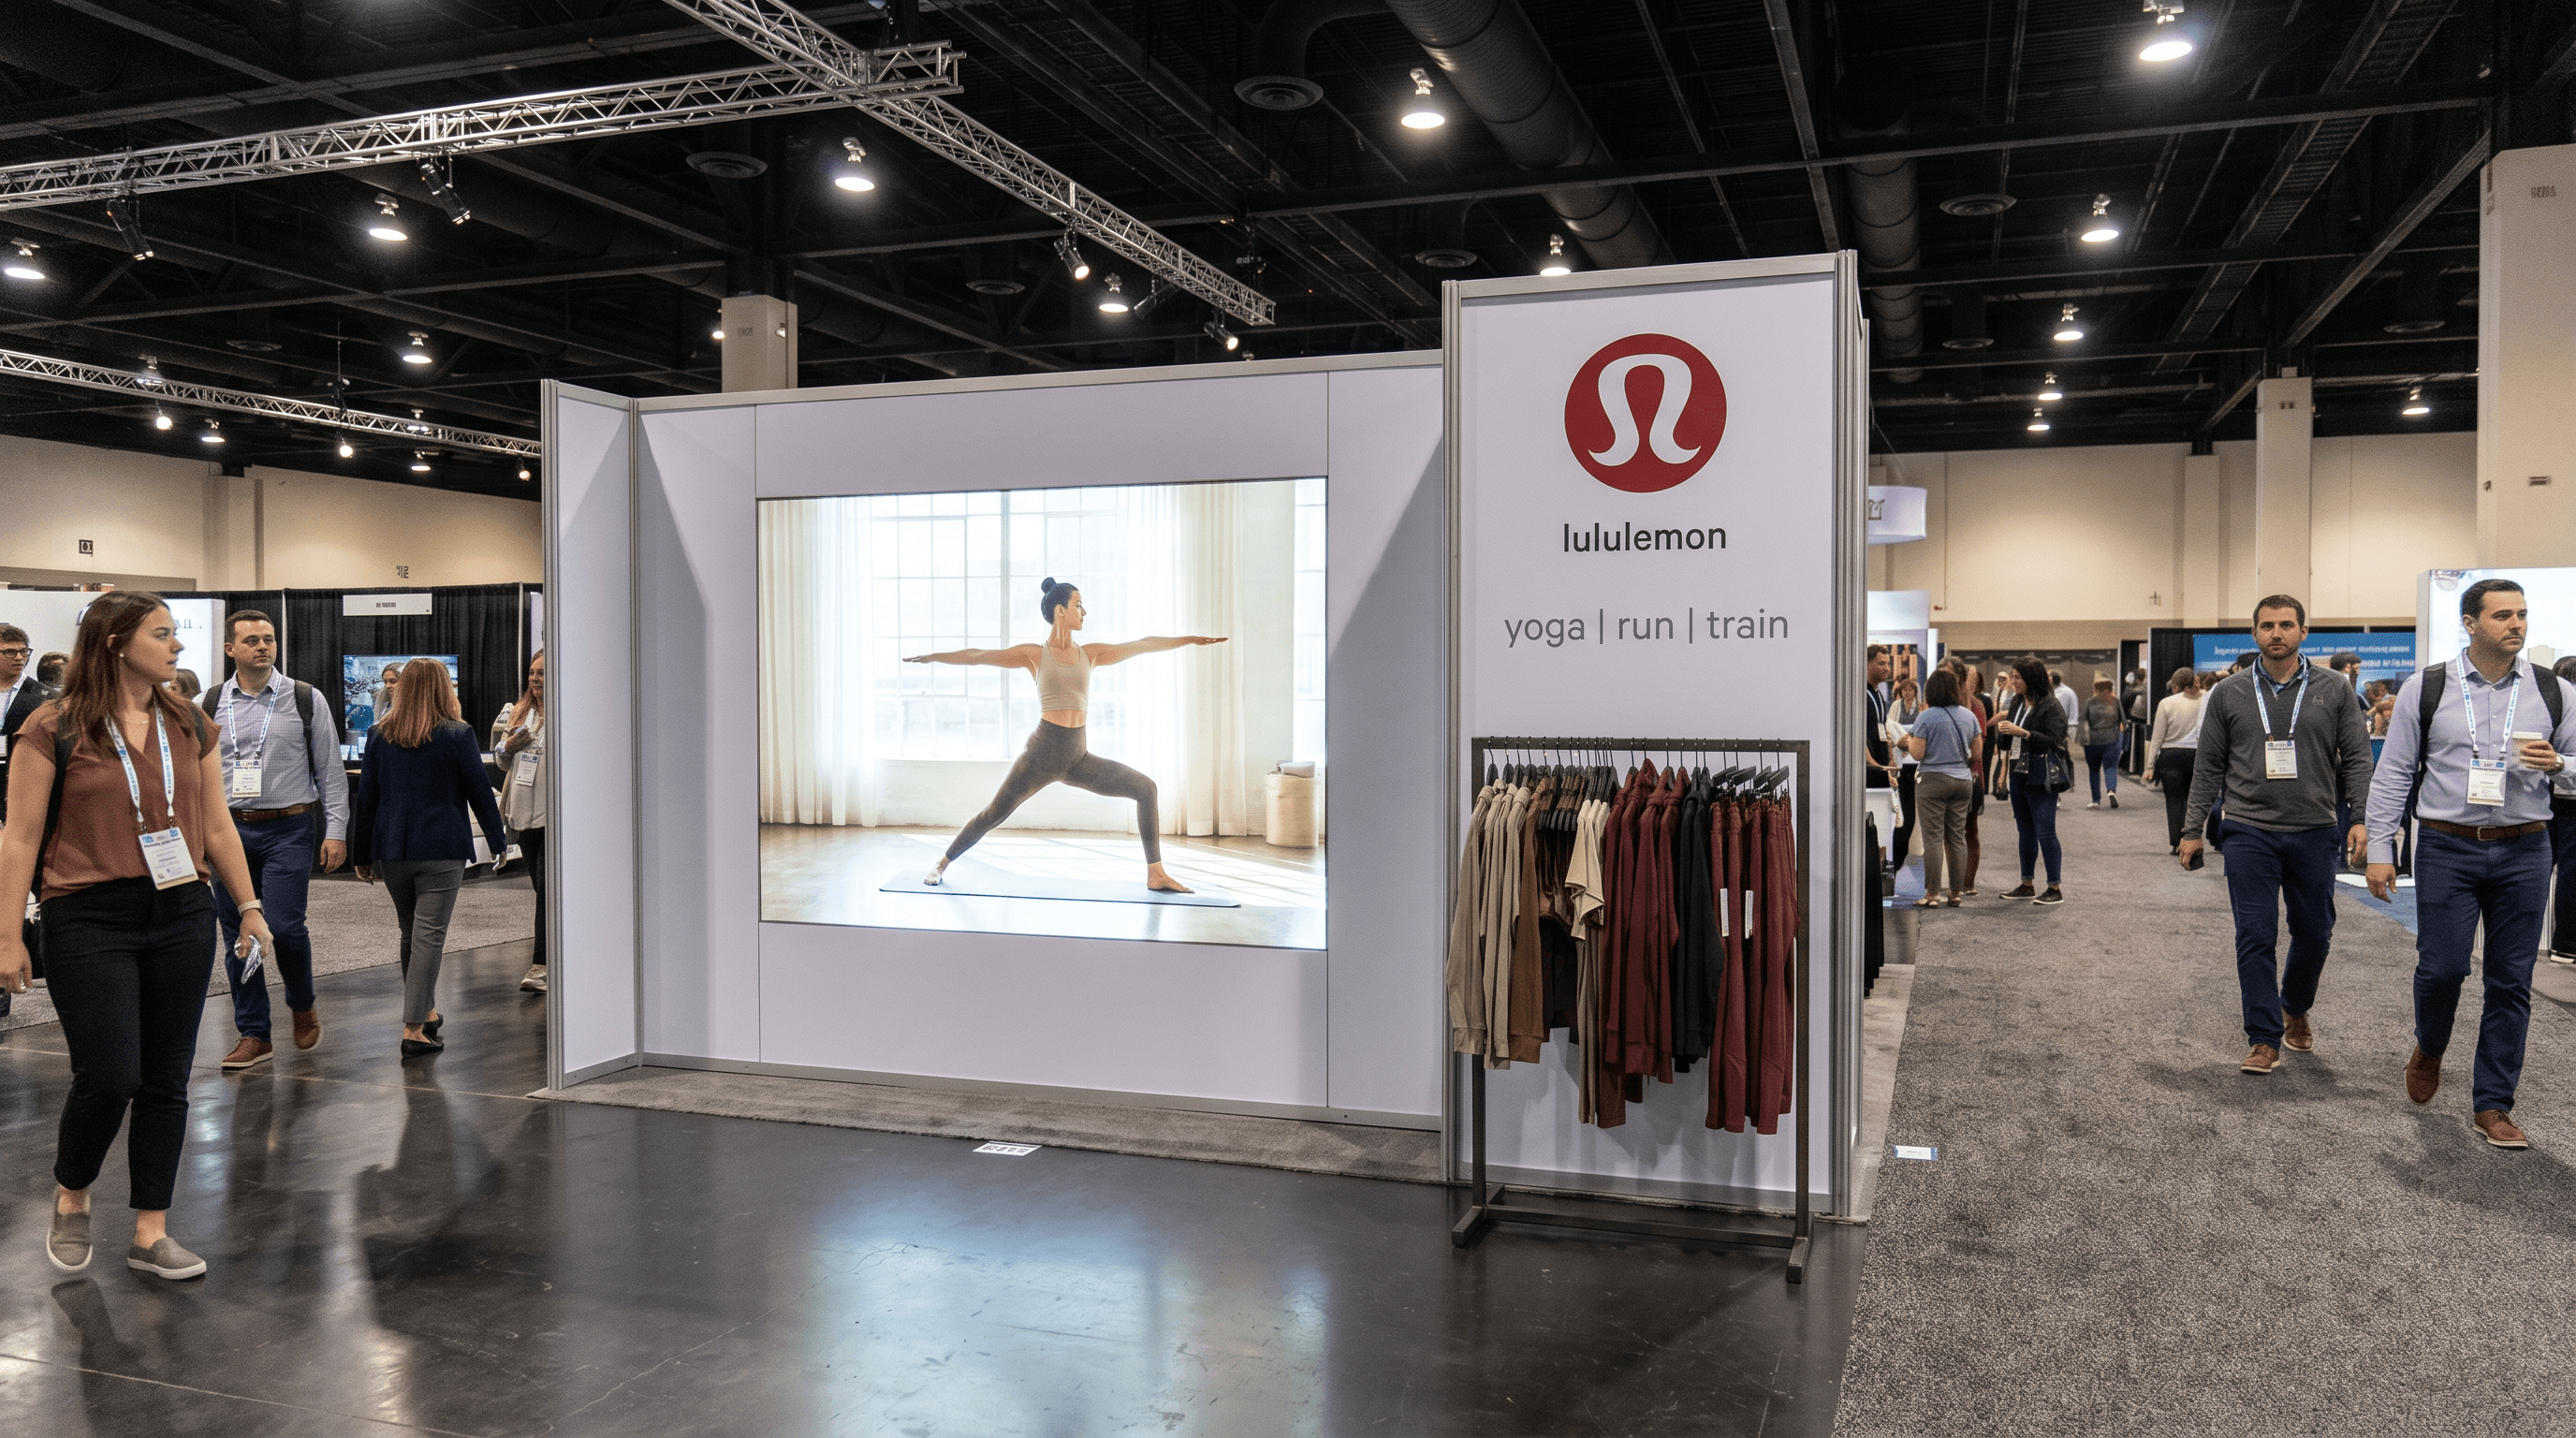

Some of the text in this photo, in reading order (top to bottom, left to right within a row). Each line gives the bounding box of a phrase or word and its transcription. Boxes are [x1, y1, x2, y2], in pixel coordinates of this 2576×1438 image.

[1563, 521, 1726, 552] lululemon
[1503, 618, 1585, 648] yoga
[1617, 617, 1674, 640] run
[1705, 608, 1788, 639] train
